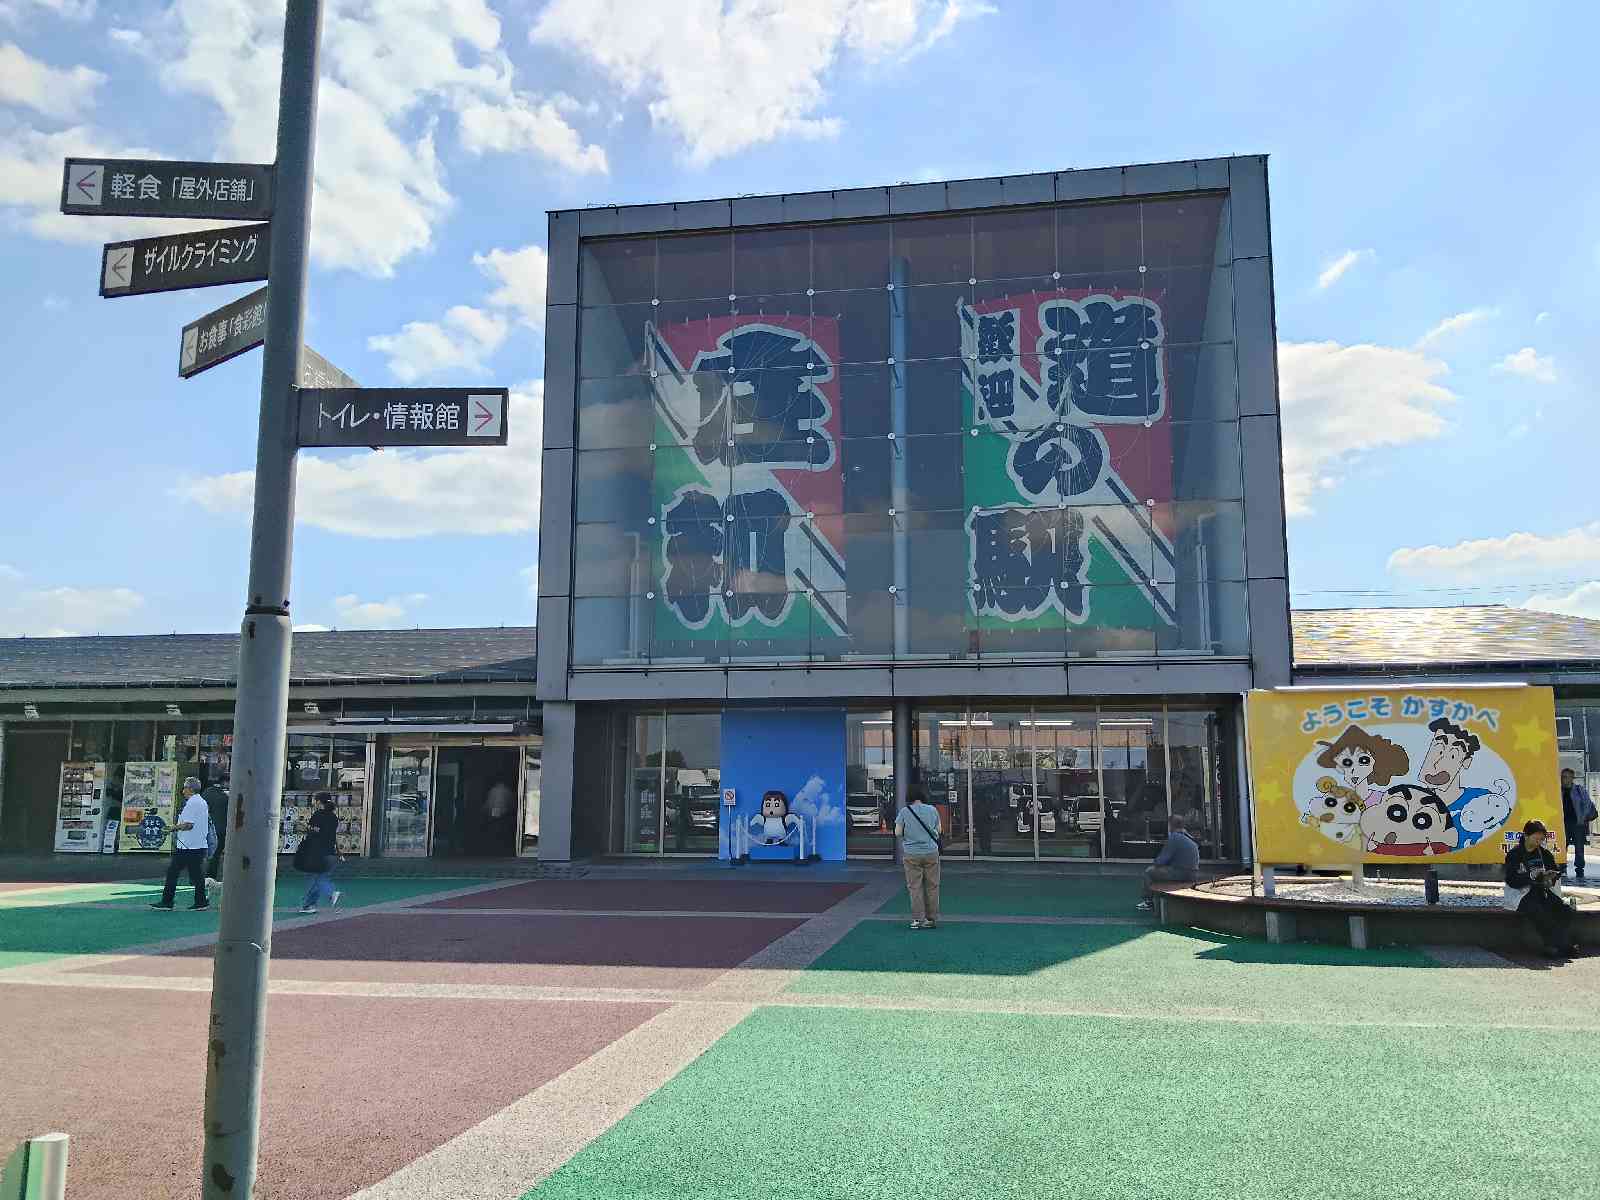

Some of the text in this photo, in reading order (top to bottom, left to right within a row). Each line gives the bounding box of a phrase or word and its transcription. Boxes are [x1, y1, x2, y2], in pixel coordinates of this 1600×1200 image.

[110, 174, 254, 201] 軽食 「屋外店舗」
[144, 233, 259, 275] ザイルクライミング
[318, 401, 460, 431] トイレ・情報館
[1302, 696, 1497, 731] ようこそ かすかべ
